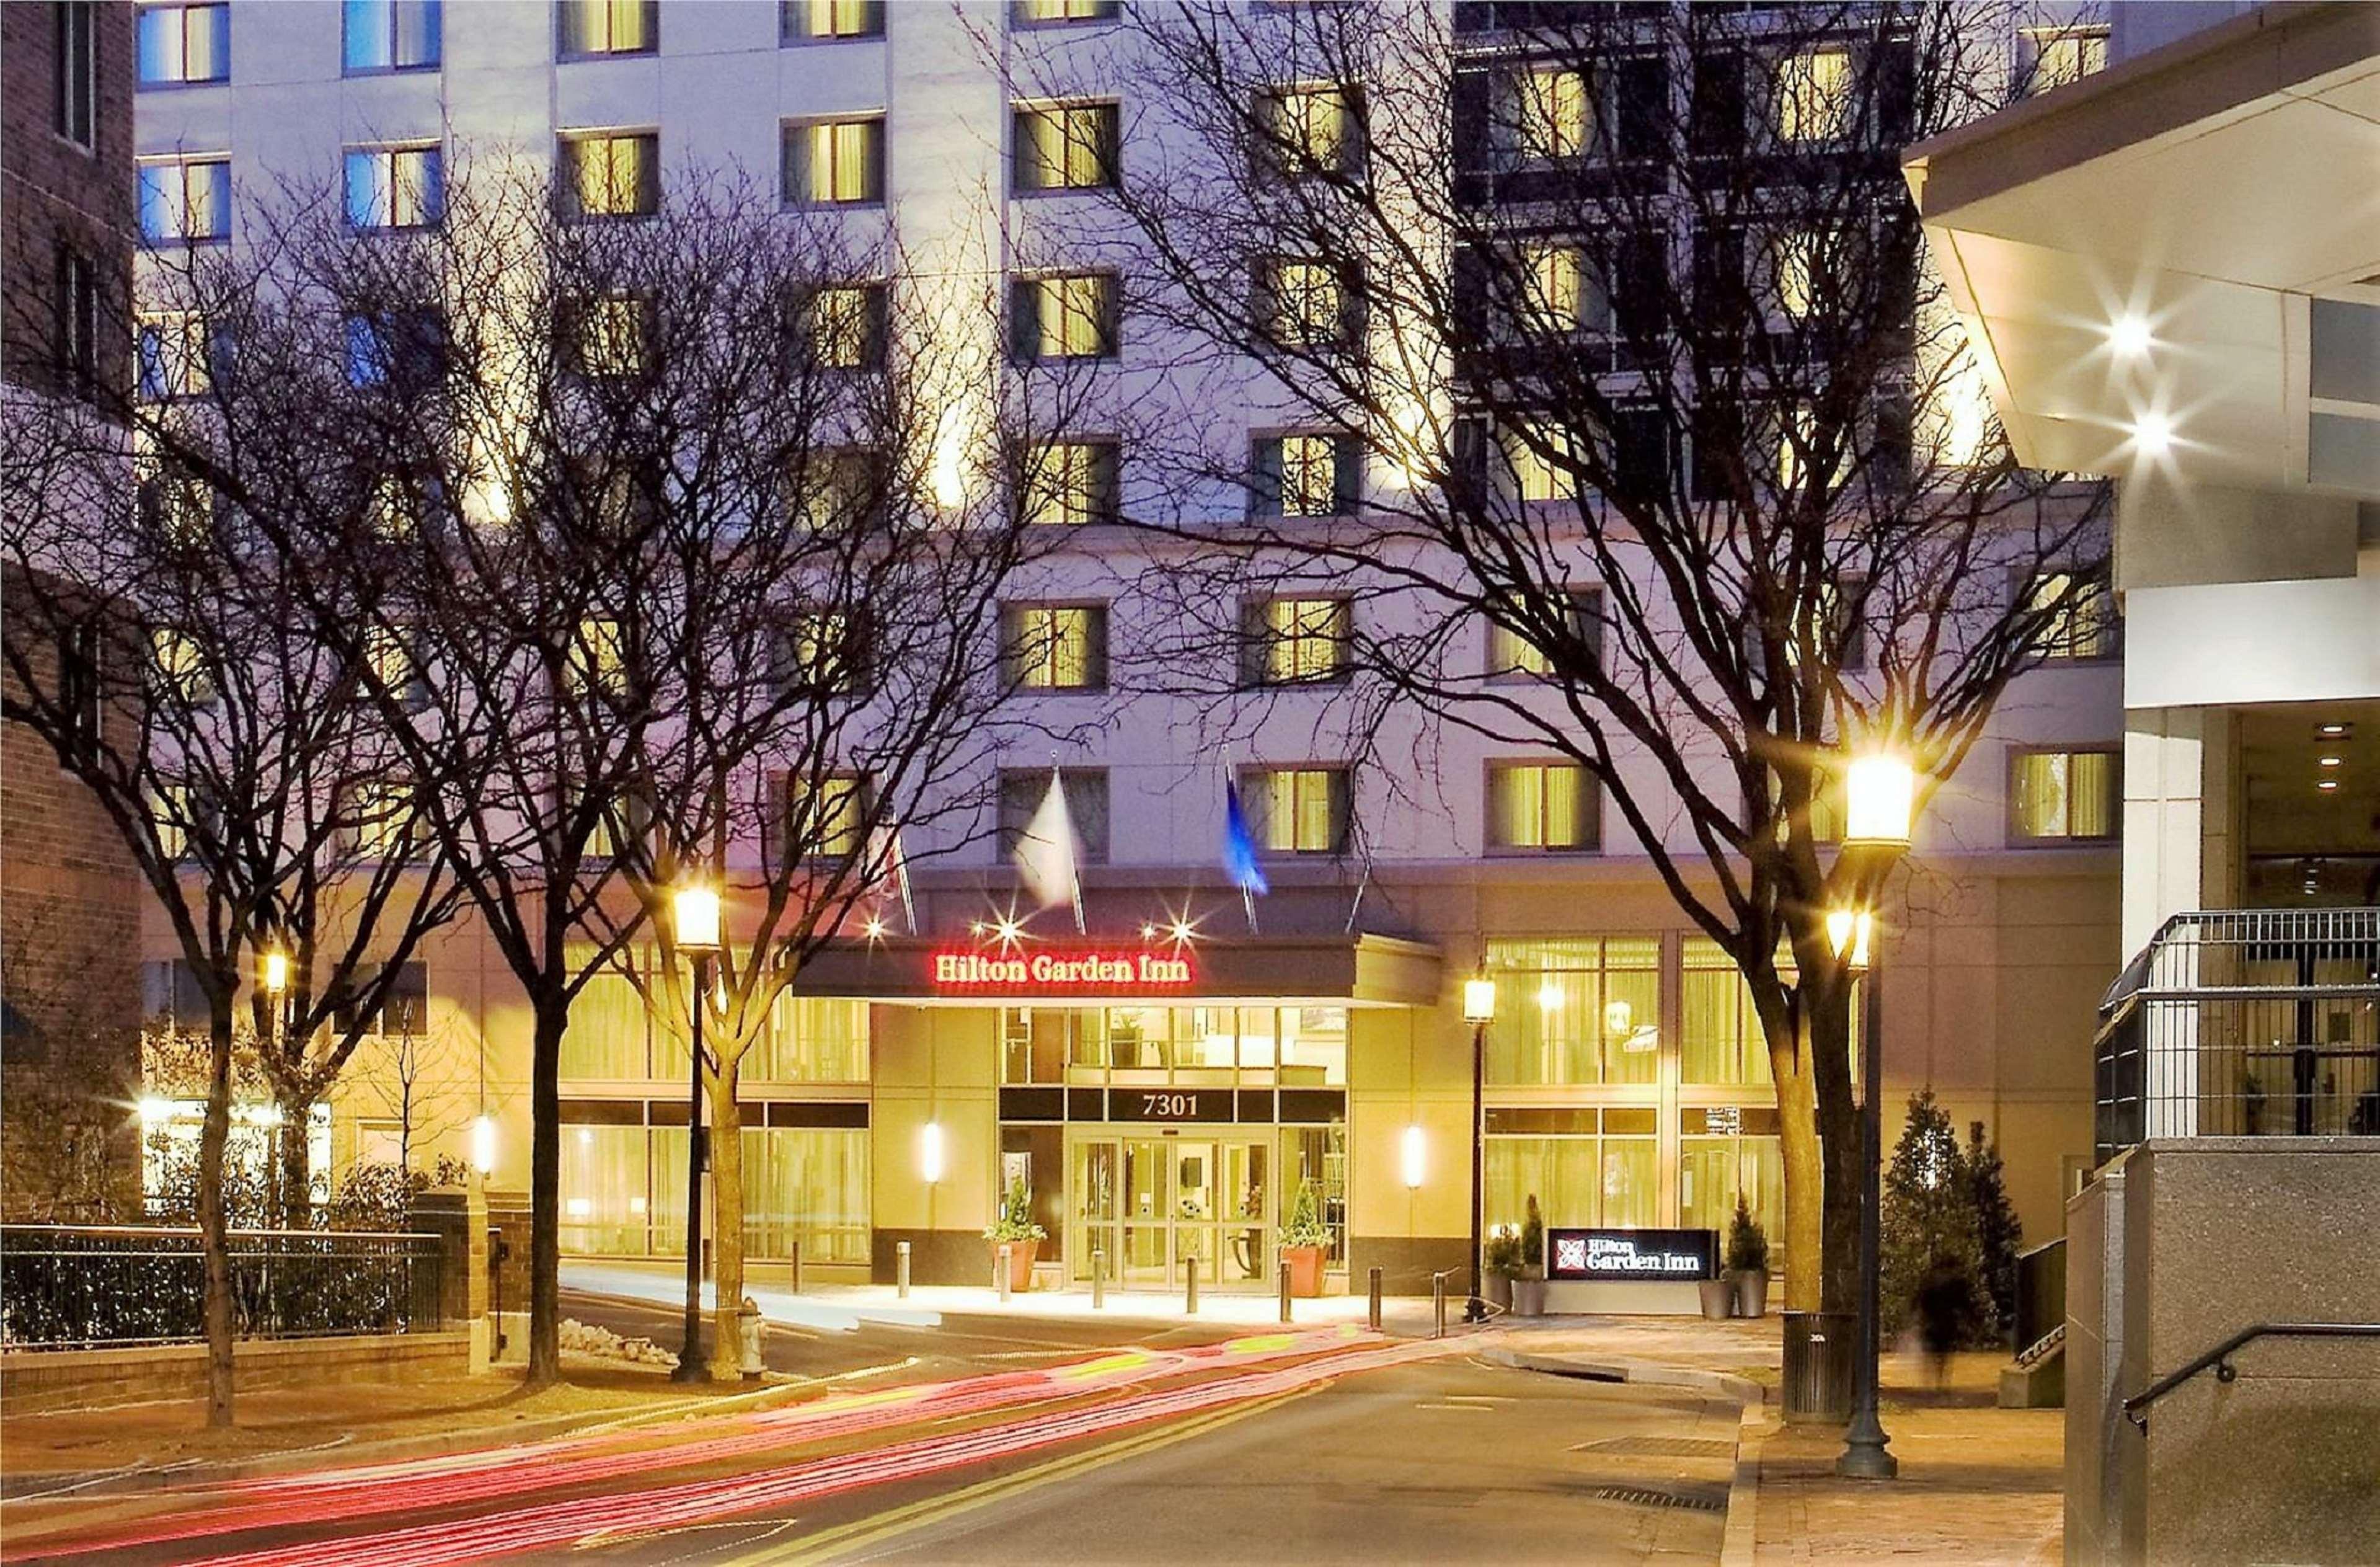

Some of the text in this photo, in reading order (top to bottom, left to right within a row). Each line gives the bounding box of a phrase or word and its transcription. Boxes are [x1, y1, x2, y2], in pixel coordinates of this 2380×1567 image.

[936, 954, 1190, 982] Hilton Garden Inn
[1143, 1094, 1197, 1116] 7301
[1588, 1239, 1635, 1253] Hilton
[1586, 1251, 1699, 1271] Garden Inn
